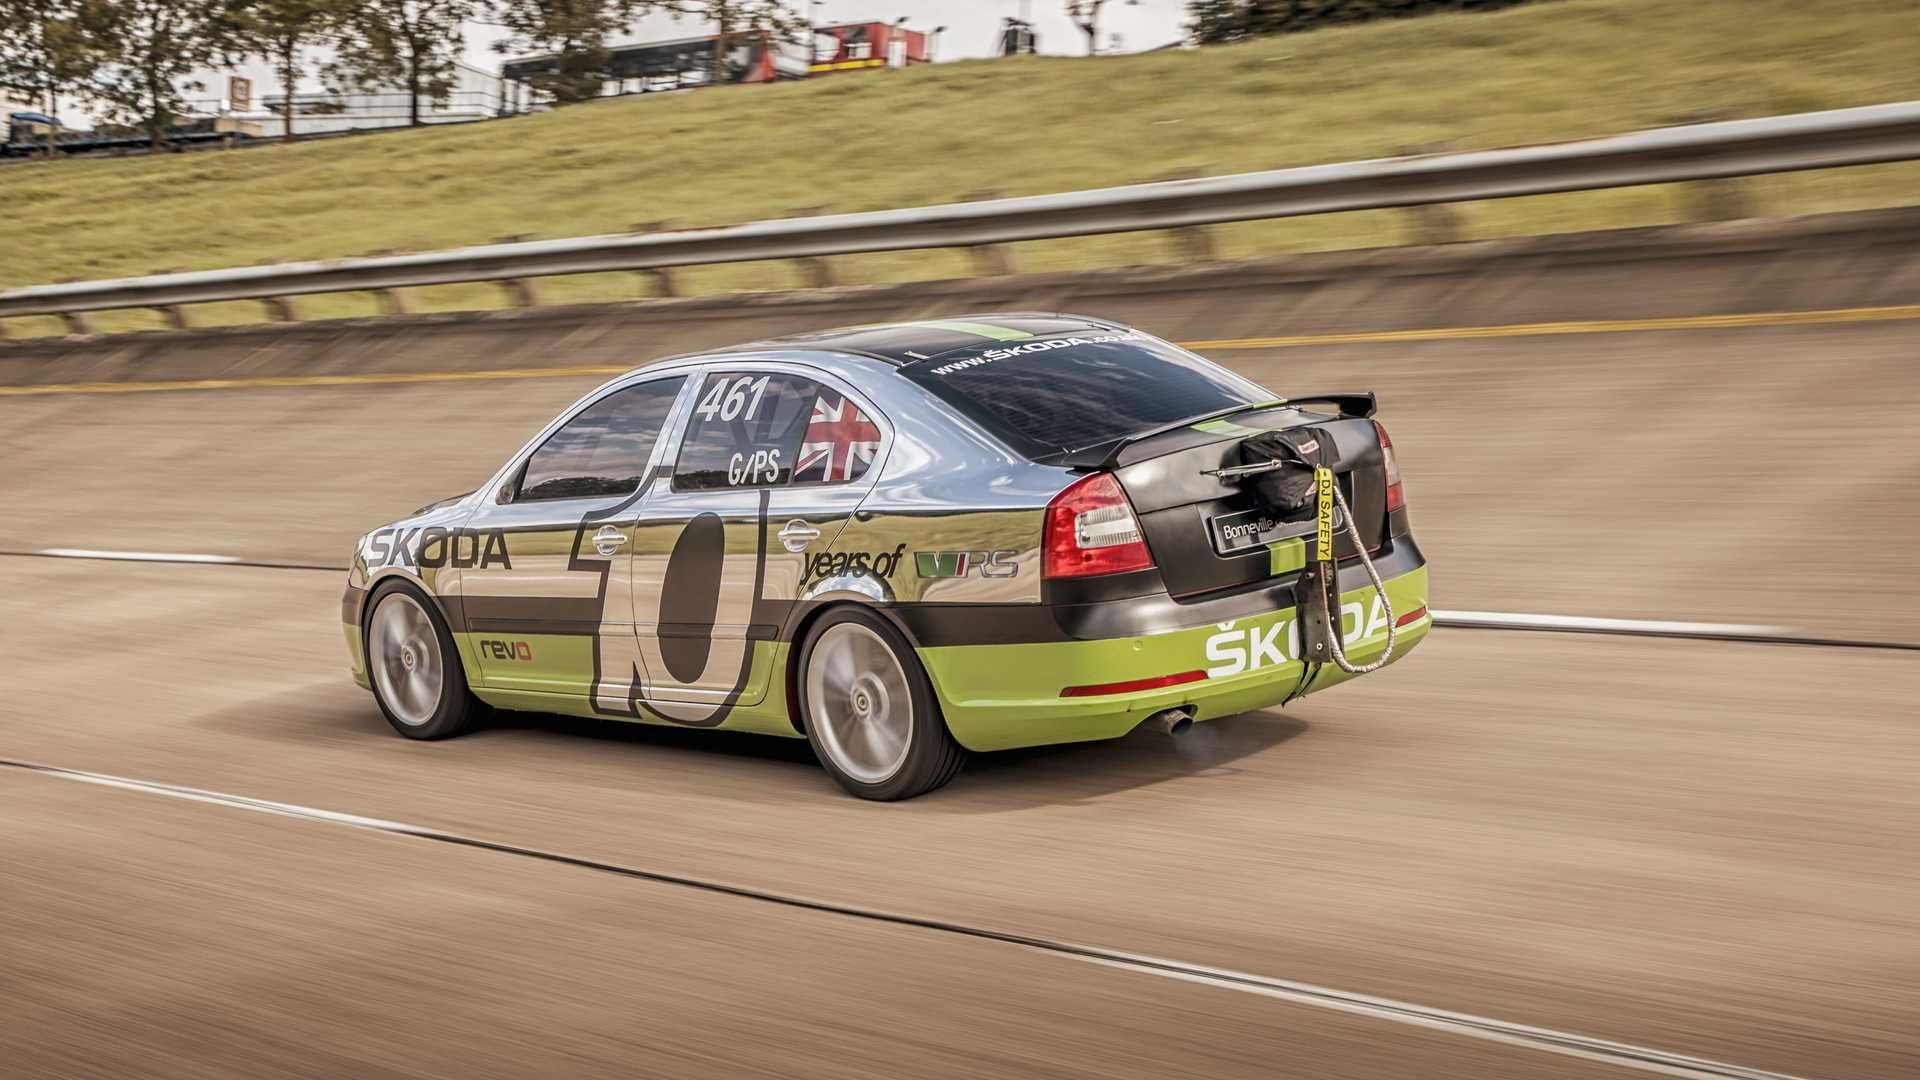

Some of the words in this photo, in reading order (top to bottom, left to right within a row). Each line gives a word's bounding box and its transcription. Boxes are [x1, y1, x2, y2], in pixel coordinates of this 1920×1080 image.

[697, 376, 771, 422] 461
[728, 449, 781, 486] G/PS
[1320, 479, 1331, 497] DJ
[1223, 517, 1273, 540] Bonneville
[1319, 503, 1331, 558] SAFETY
[801, 550, 871, 586] years
[871, 543, 907, 579] of
[1206, 594, 1389, 679] ŠKDA
